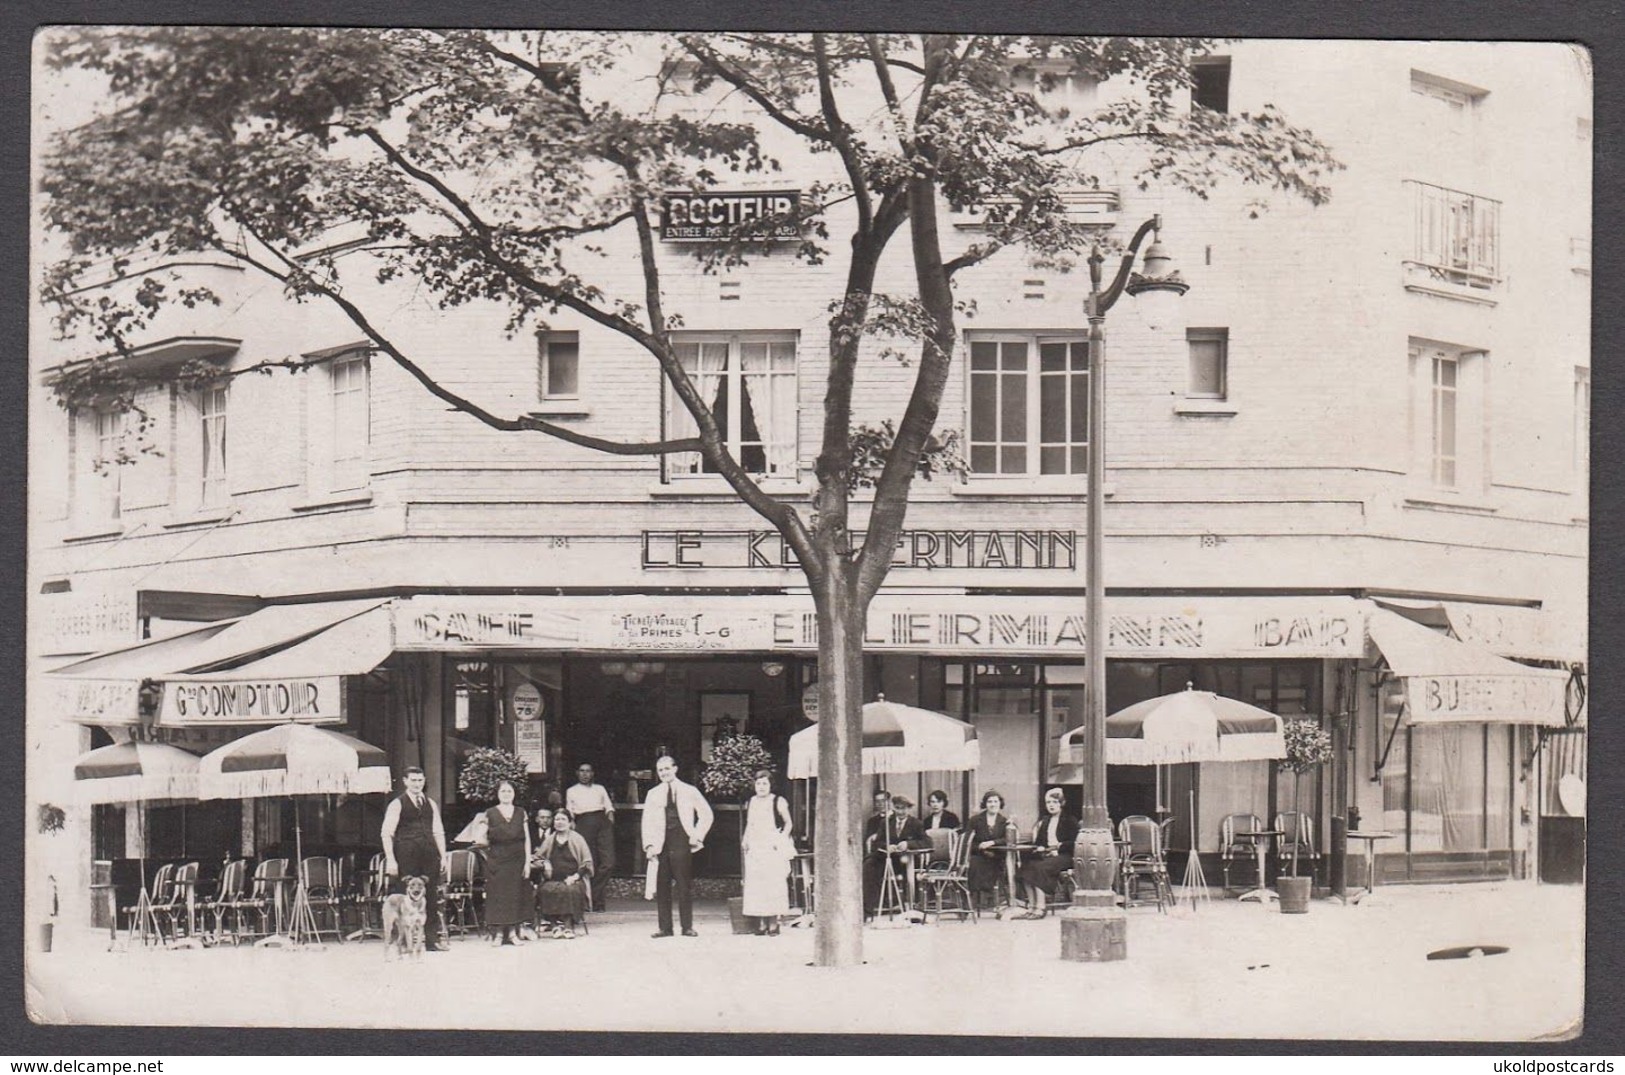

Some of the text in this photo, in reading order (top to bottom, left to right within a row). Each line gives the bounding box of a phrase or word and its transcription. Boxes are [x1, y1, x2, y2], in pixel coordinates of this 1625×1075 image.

[641, 530, 1076, 569] LE KEERMANN
[641, 627, 683, 638] PRIMES
[1254, 616, 1350, 648] BAR
